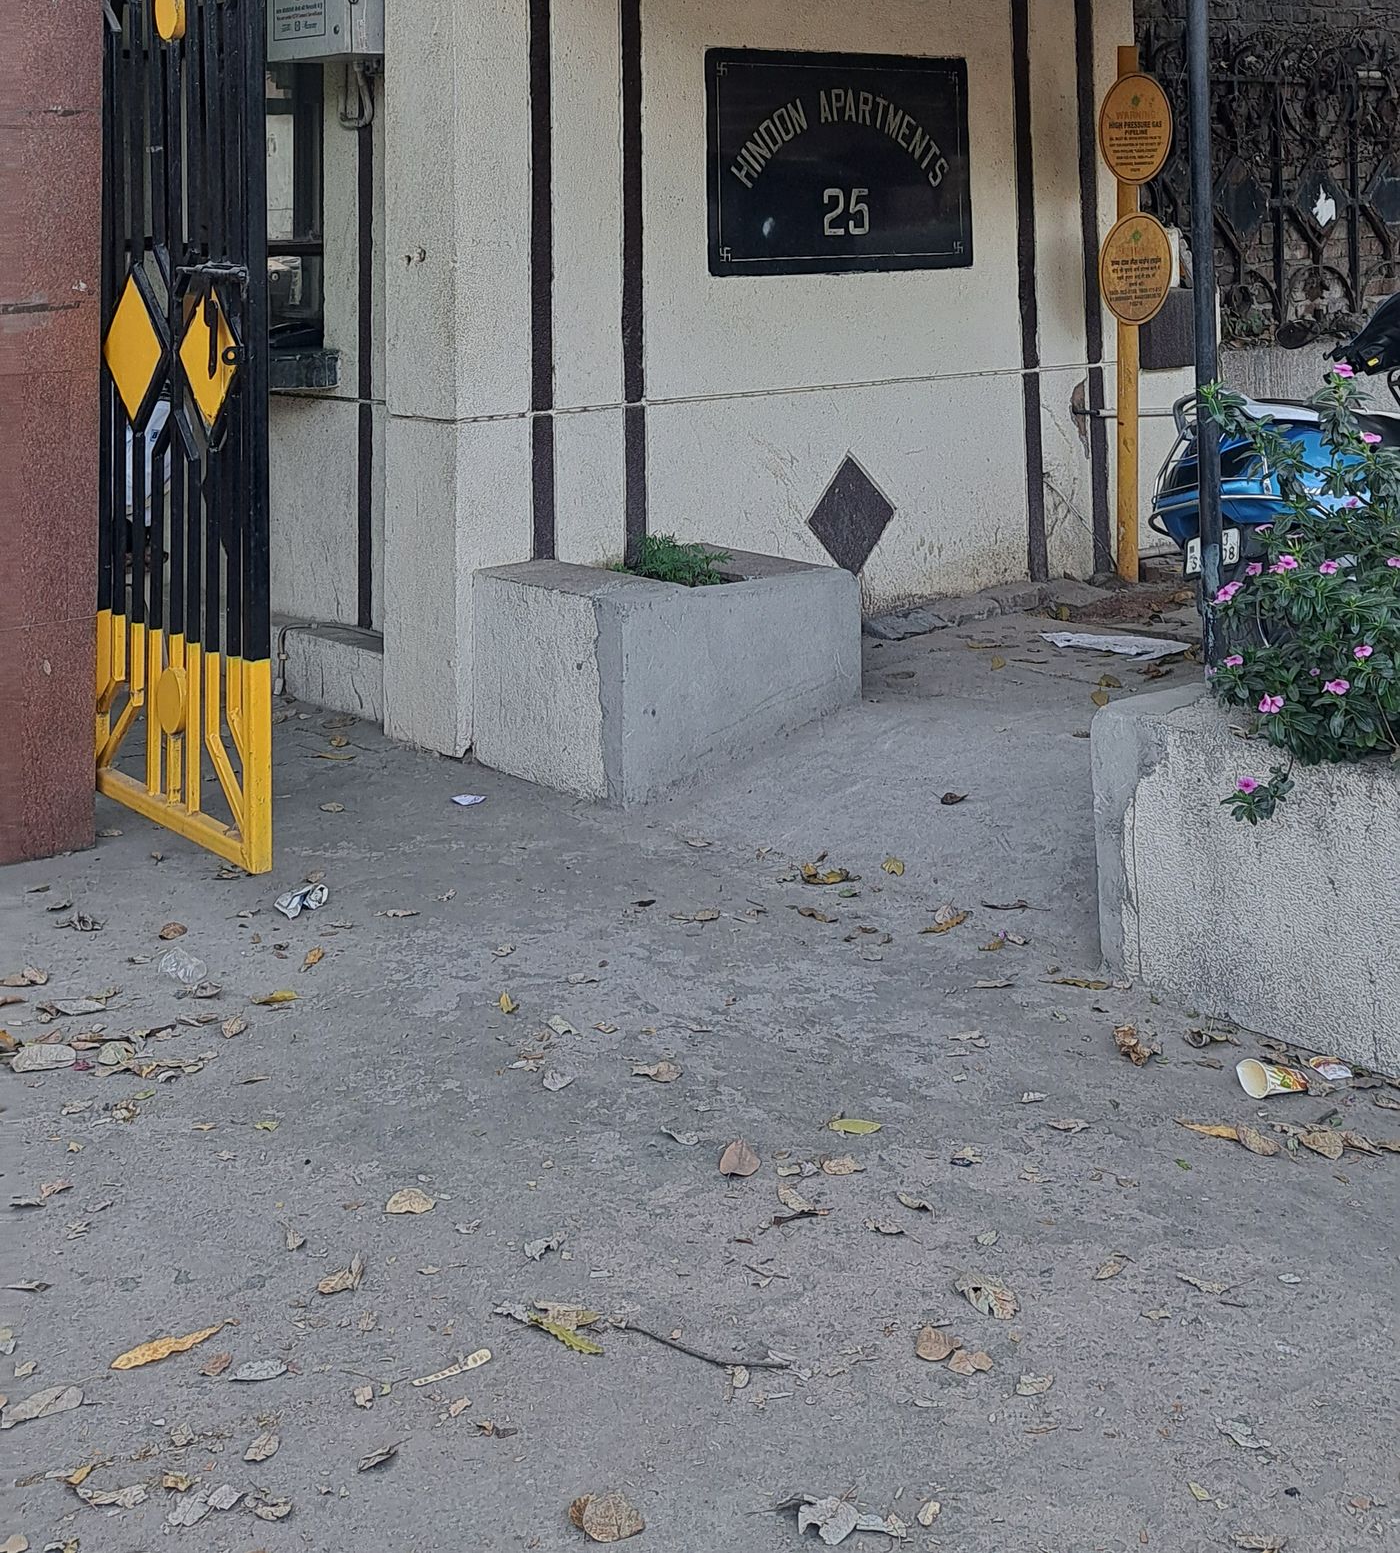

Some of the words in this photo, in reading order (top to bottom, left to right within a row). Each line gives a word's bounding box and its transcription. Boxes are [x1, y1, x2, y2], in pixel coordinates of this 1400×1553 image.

[730, 98, 808, 188] HINDON
[819, 88, 949, 188] APARTMENTS
[1109, 121, 1123, 129] HIGH
[1124, 120, 1151, 129] PRESSURE
[1151, 120, 1163, 128] GAS
[823, 188, 870, 235] 25
